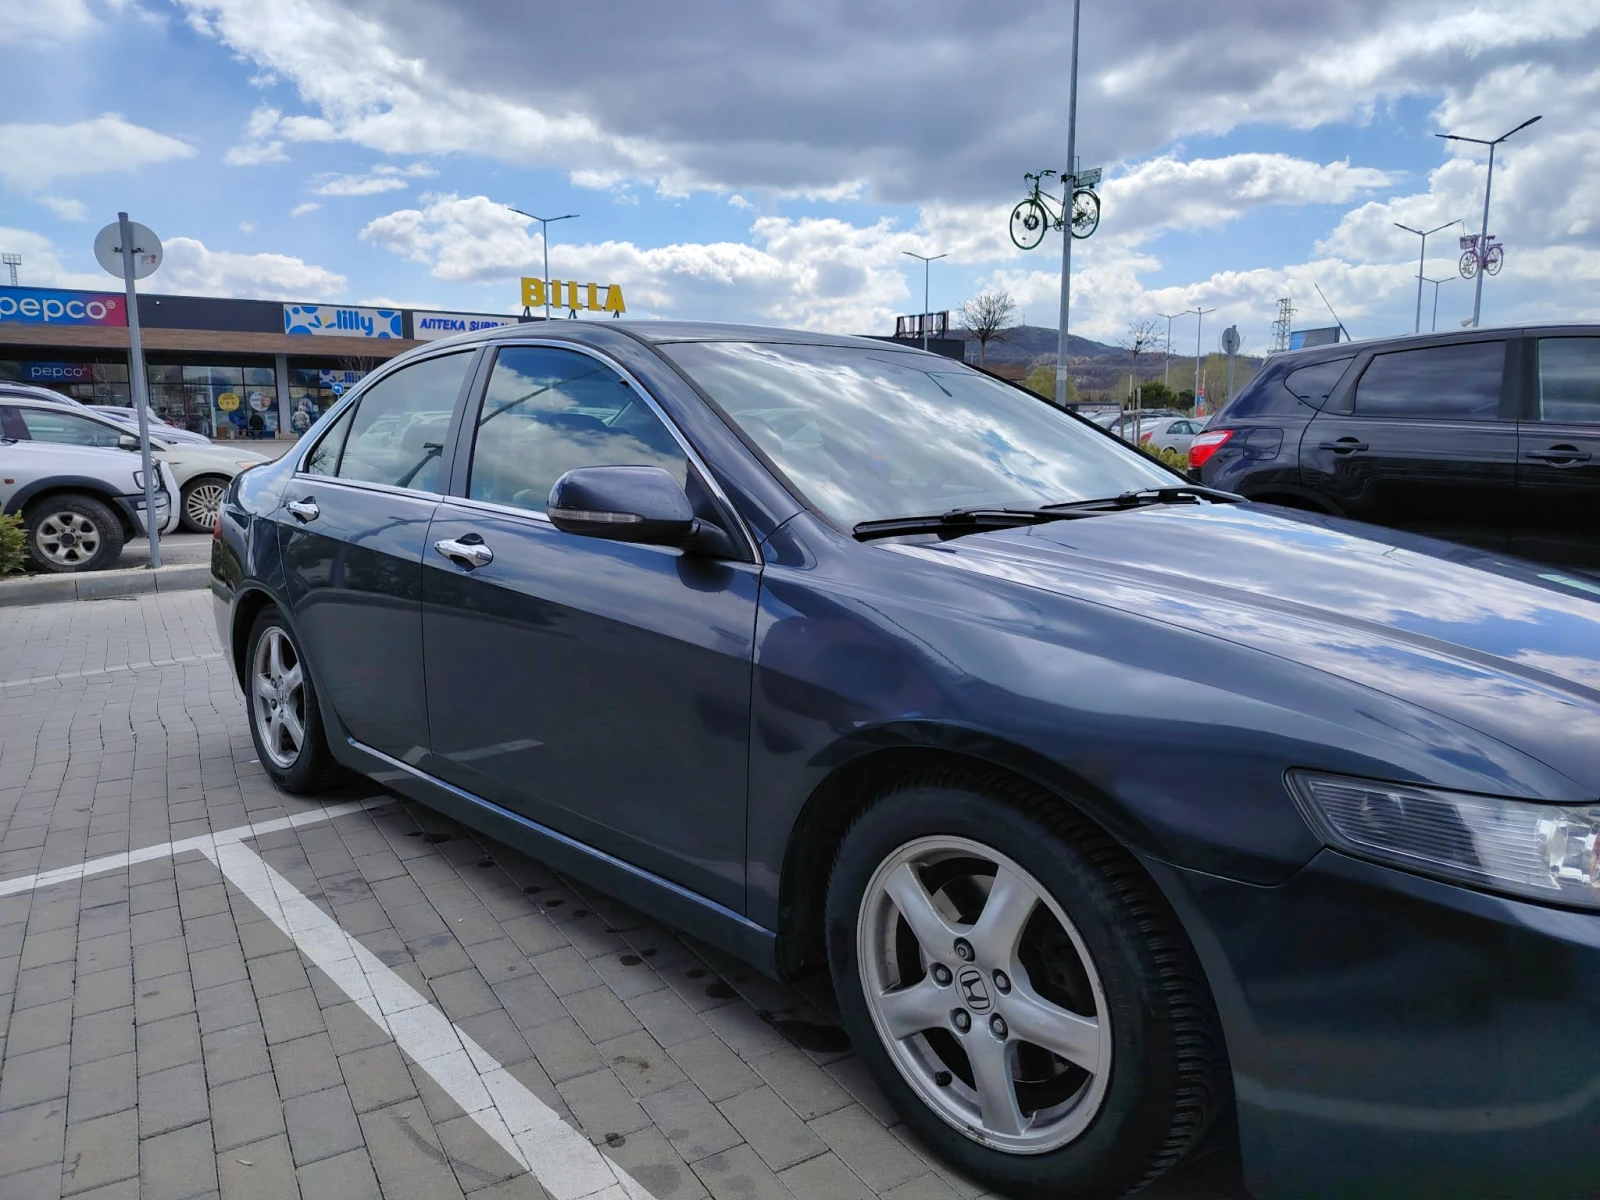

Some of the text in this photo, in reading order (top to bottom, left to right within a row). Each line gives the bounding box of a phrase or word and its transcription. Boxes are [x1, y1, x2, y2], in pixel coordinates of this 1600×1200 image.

[521, 277, 626, 313] BILLA
[0, 297, 107, 322] pepco
[336, 309, 374, 337] lilly
[420, 318, 466, 332] АПТЕКА
[31, 366, 83, 378] pepco
